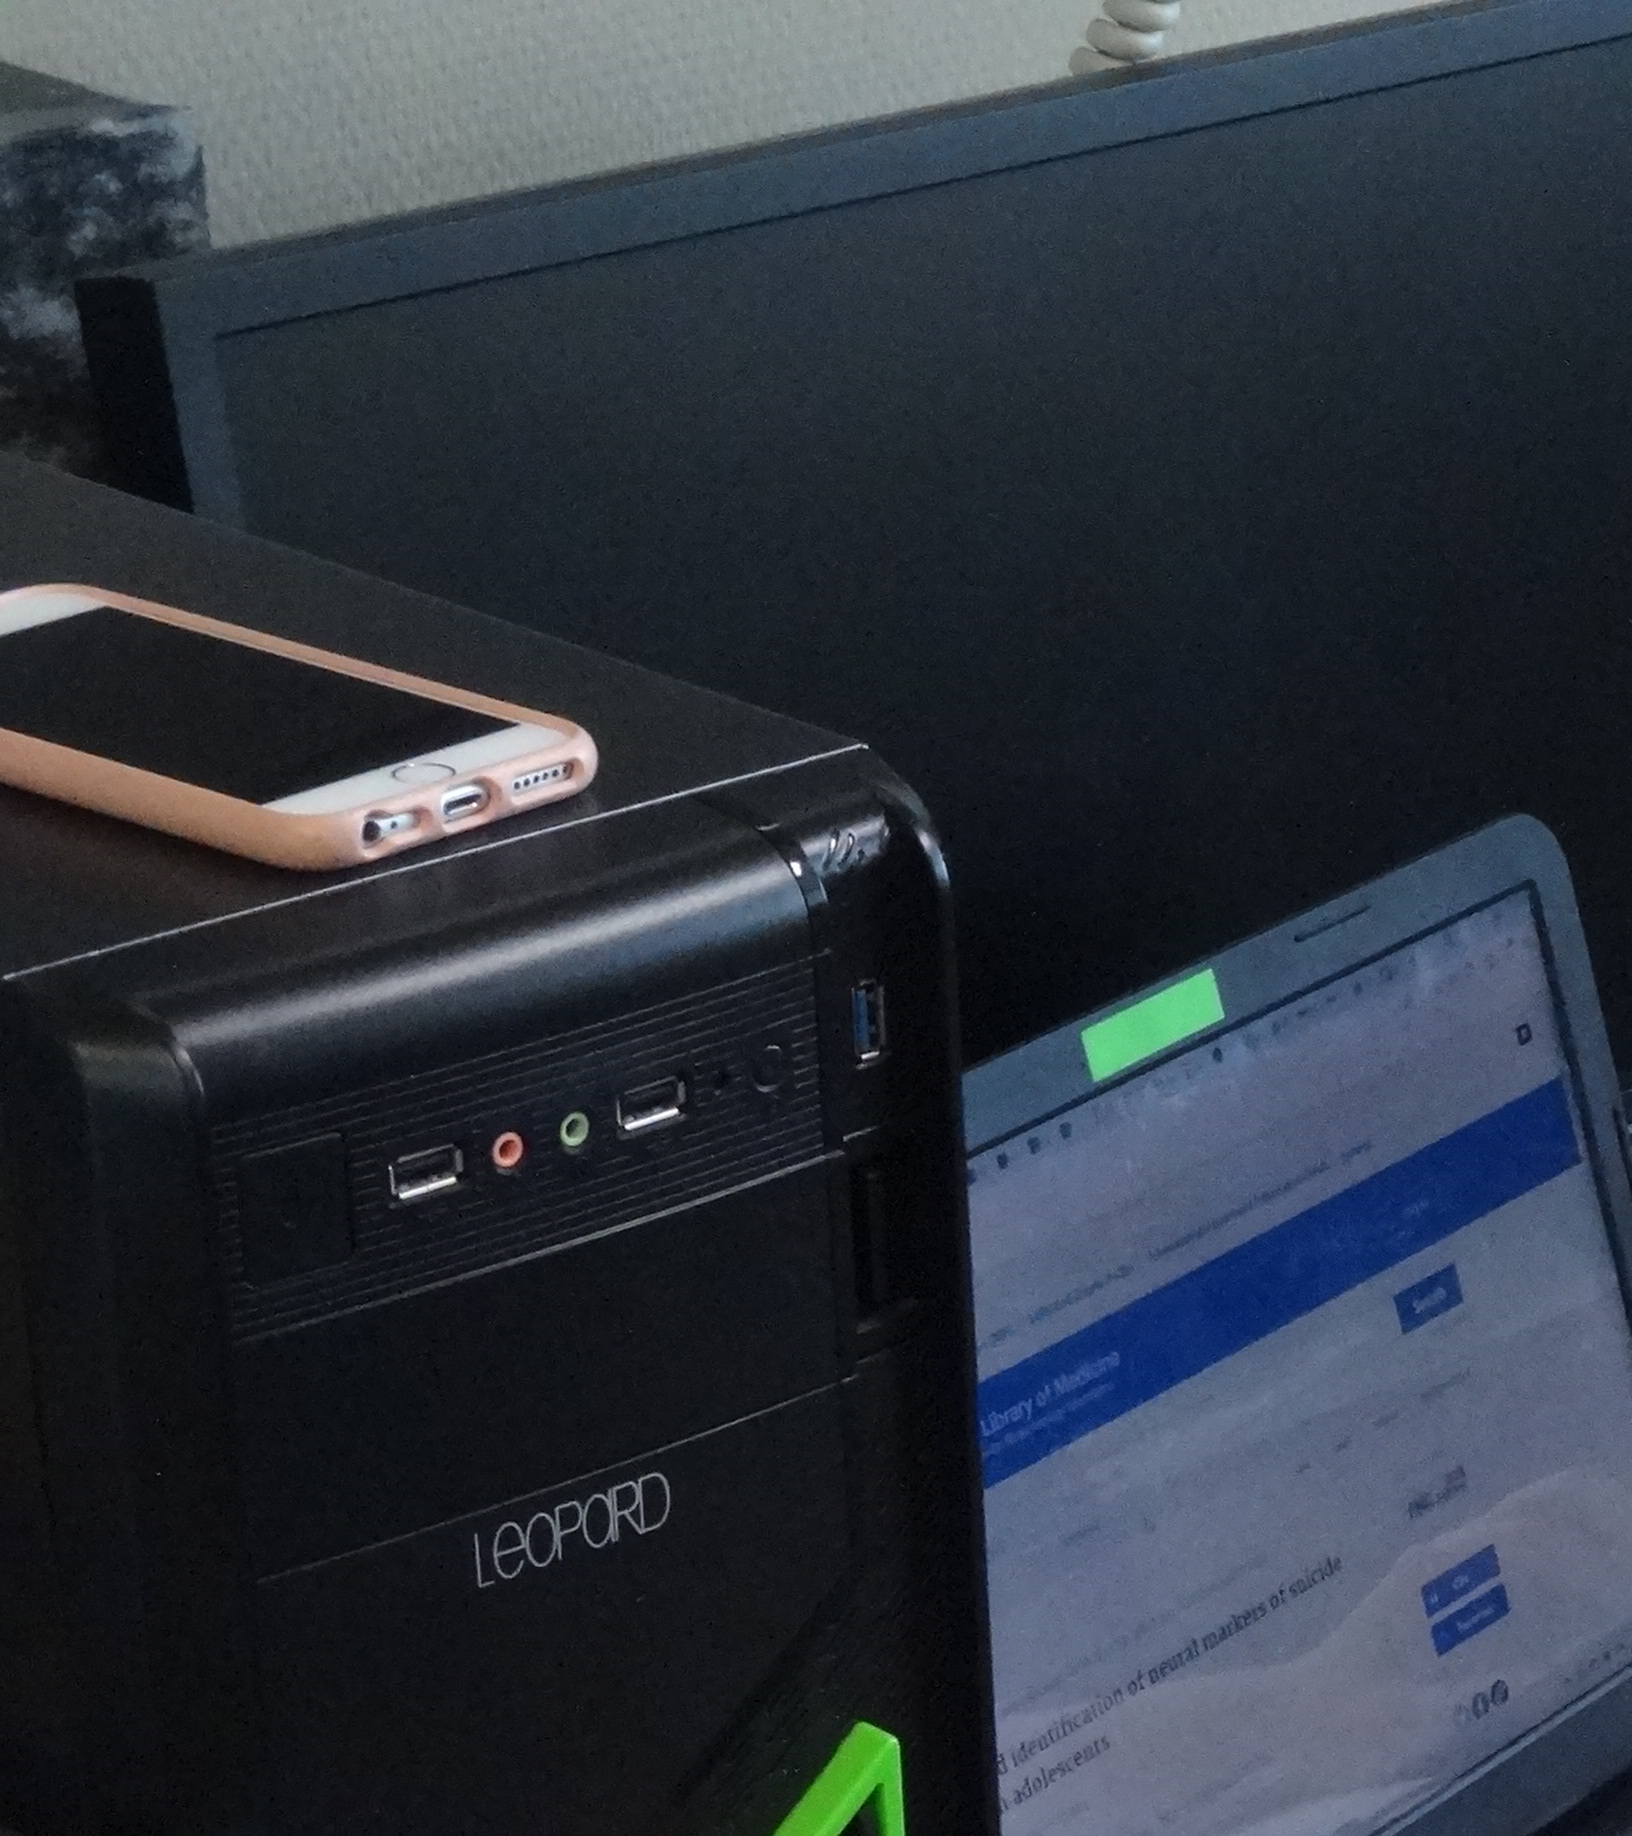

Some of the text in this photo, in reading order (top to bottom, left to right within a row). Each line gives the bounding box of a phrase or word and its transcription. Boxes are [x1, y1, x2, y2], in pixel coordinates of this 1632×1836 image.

[1011, 1686, 1124, 1768] identification
[1127, 1669, 1148, 1698] of
[1149, 1638, 1201, 1685] neural
[1201, 1604, 1268, 1652] markers
[1268, 1588, 1288, 1611] of
[1287, 1555, 1343, 1600] suicide
[1013, 1733, 1111, 1807] adolescents
